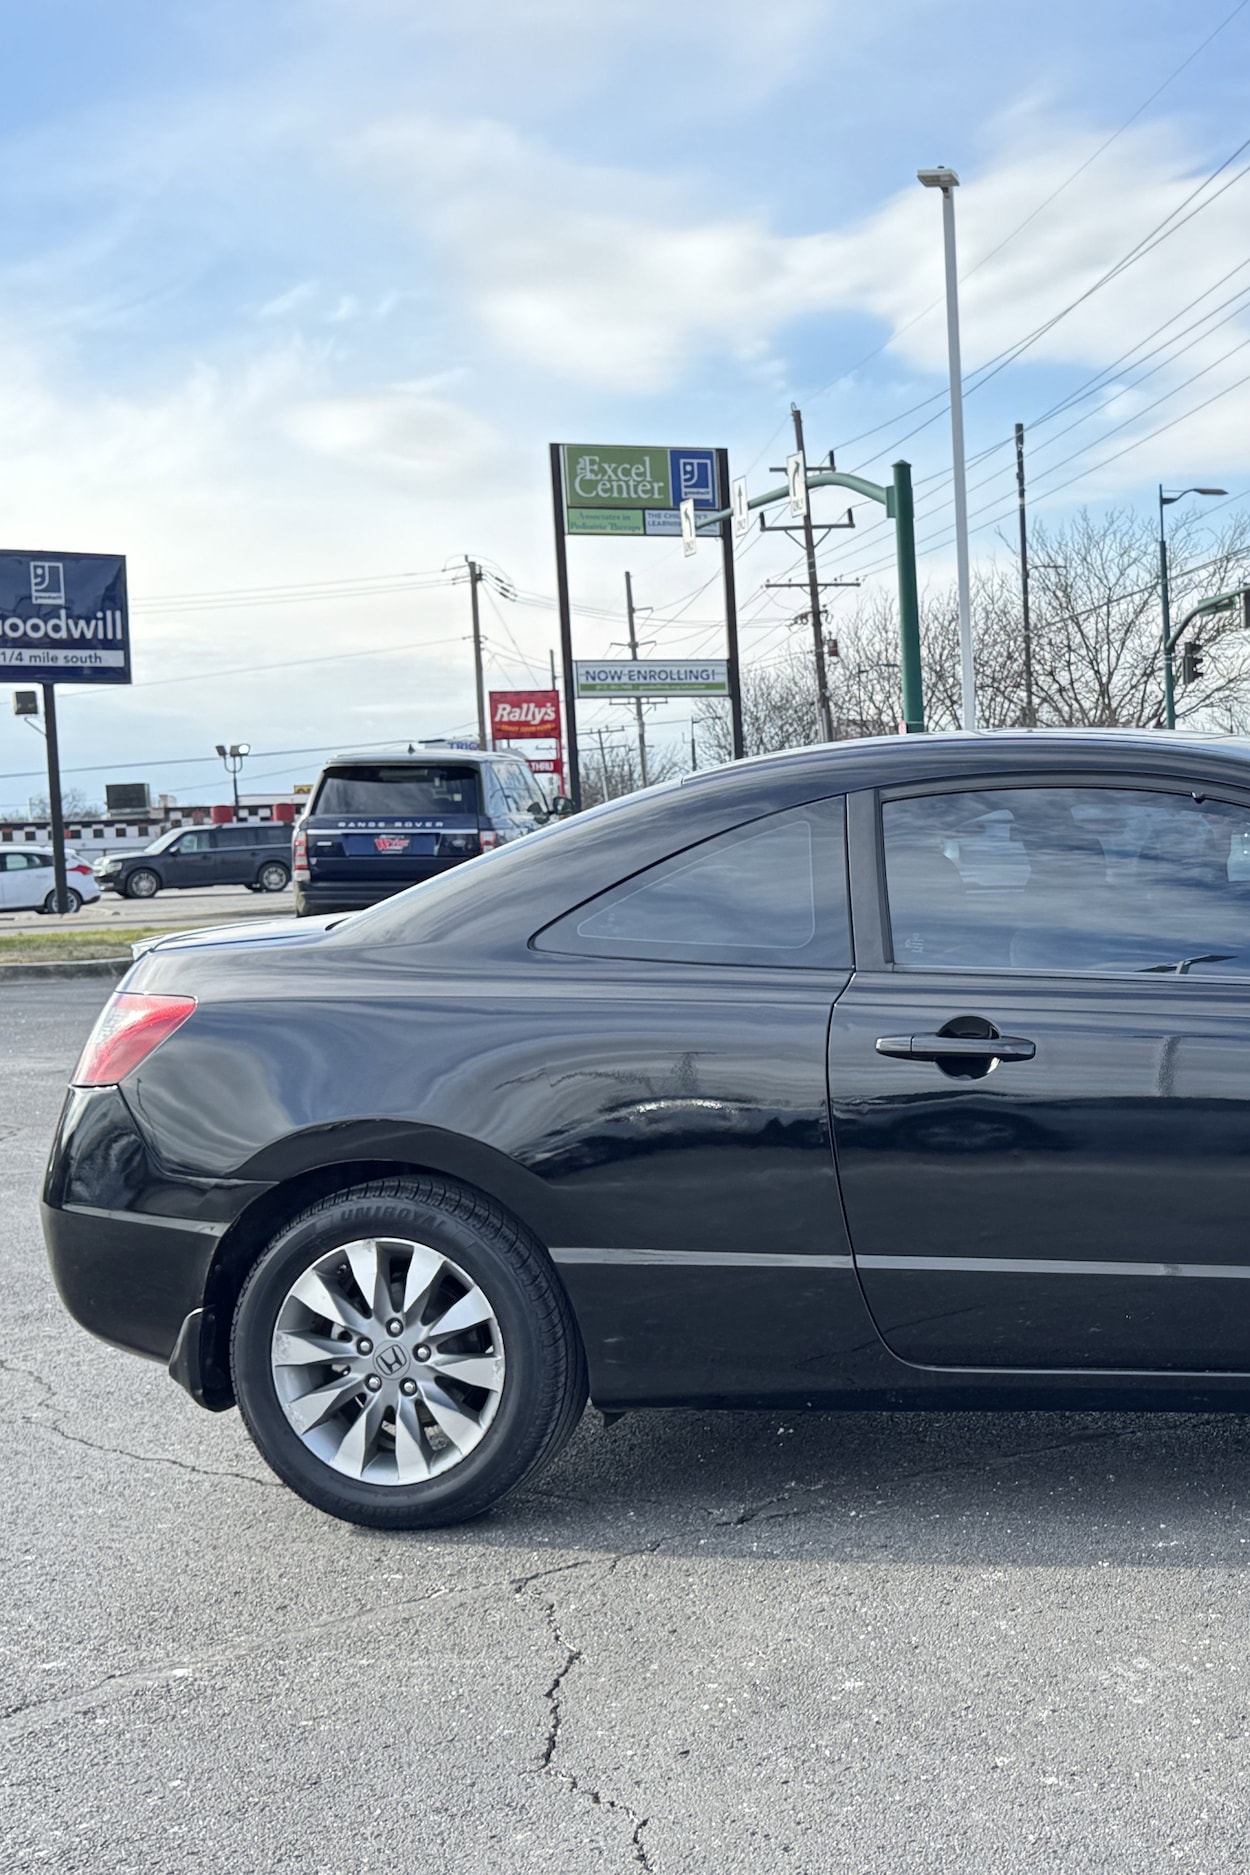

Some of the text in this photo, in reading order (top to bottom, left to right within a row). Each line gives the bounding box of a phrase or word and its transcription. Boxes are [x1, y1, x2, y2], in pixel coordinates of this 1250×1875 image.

[584, 456, 653, 481] Excel
[574, 472, 664, 499] Center
[0, 608, 122, 639] oodwill
[1, 651, 102, 665] 1/4 mile south
[585, 669, 716, 682] NOW ENROLLING!
[494, 702, 556, 725] Rally's
